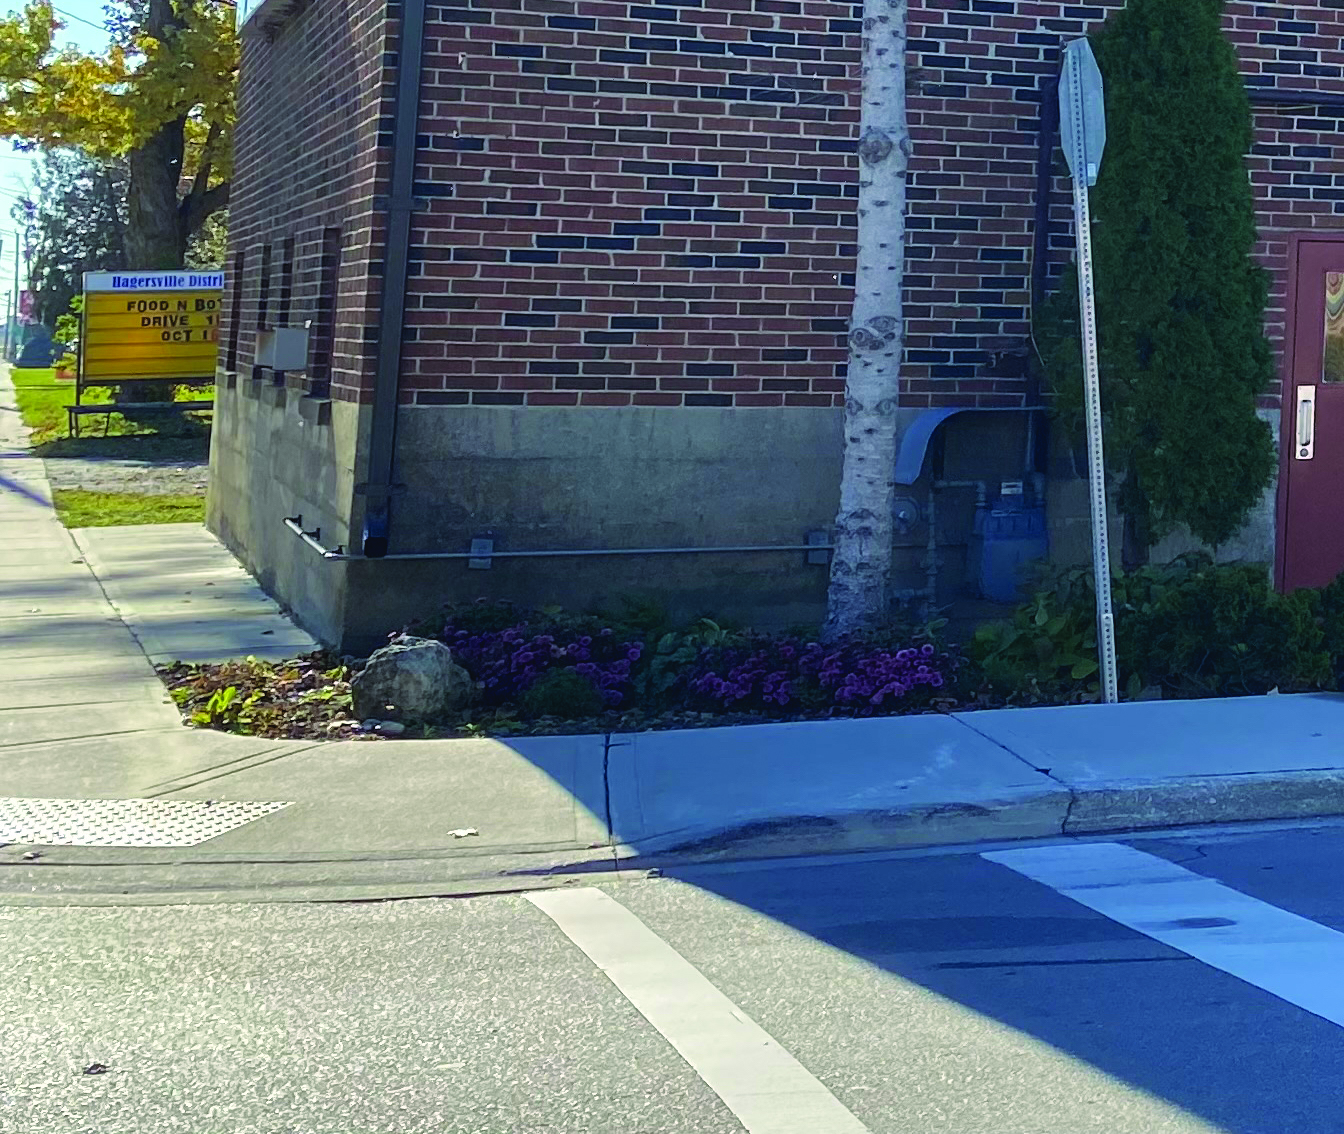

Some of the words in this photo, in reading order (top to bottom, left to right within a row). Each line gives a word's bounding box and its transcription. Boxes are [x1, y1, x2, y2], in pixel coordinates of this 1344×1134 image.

[112, 275, 185, 289] Hagersville
[127, 300, 169, 313] FOOD
[177, 300, 188, 311] N
[141, 315, 189, 328] DRIVE
[161, 329, 193, 343] OCT
